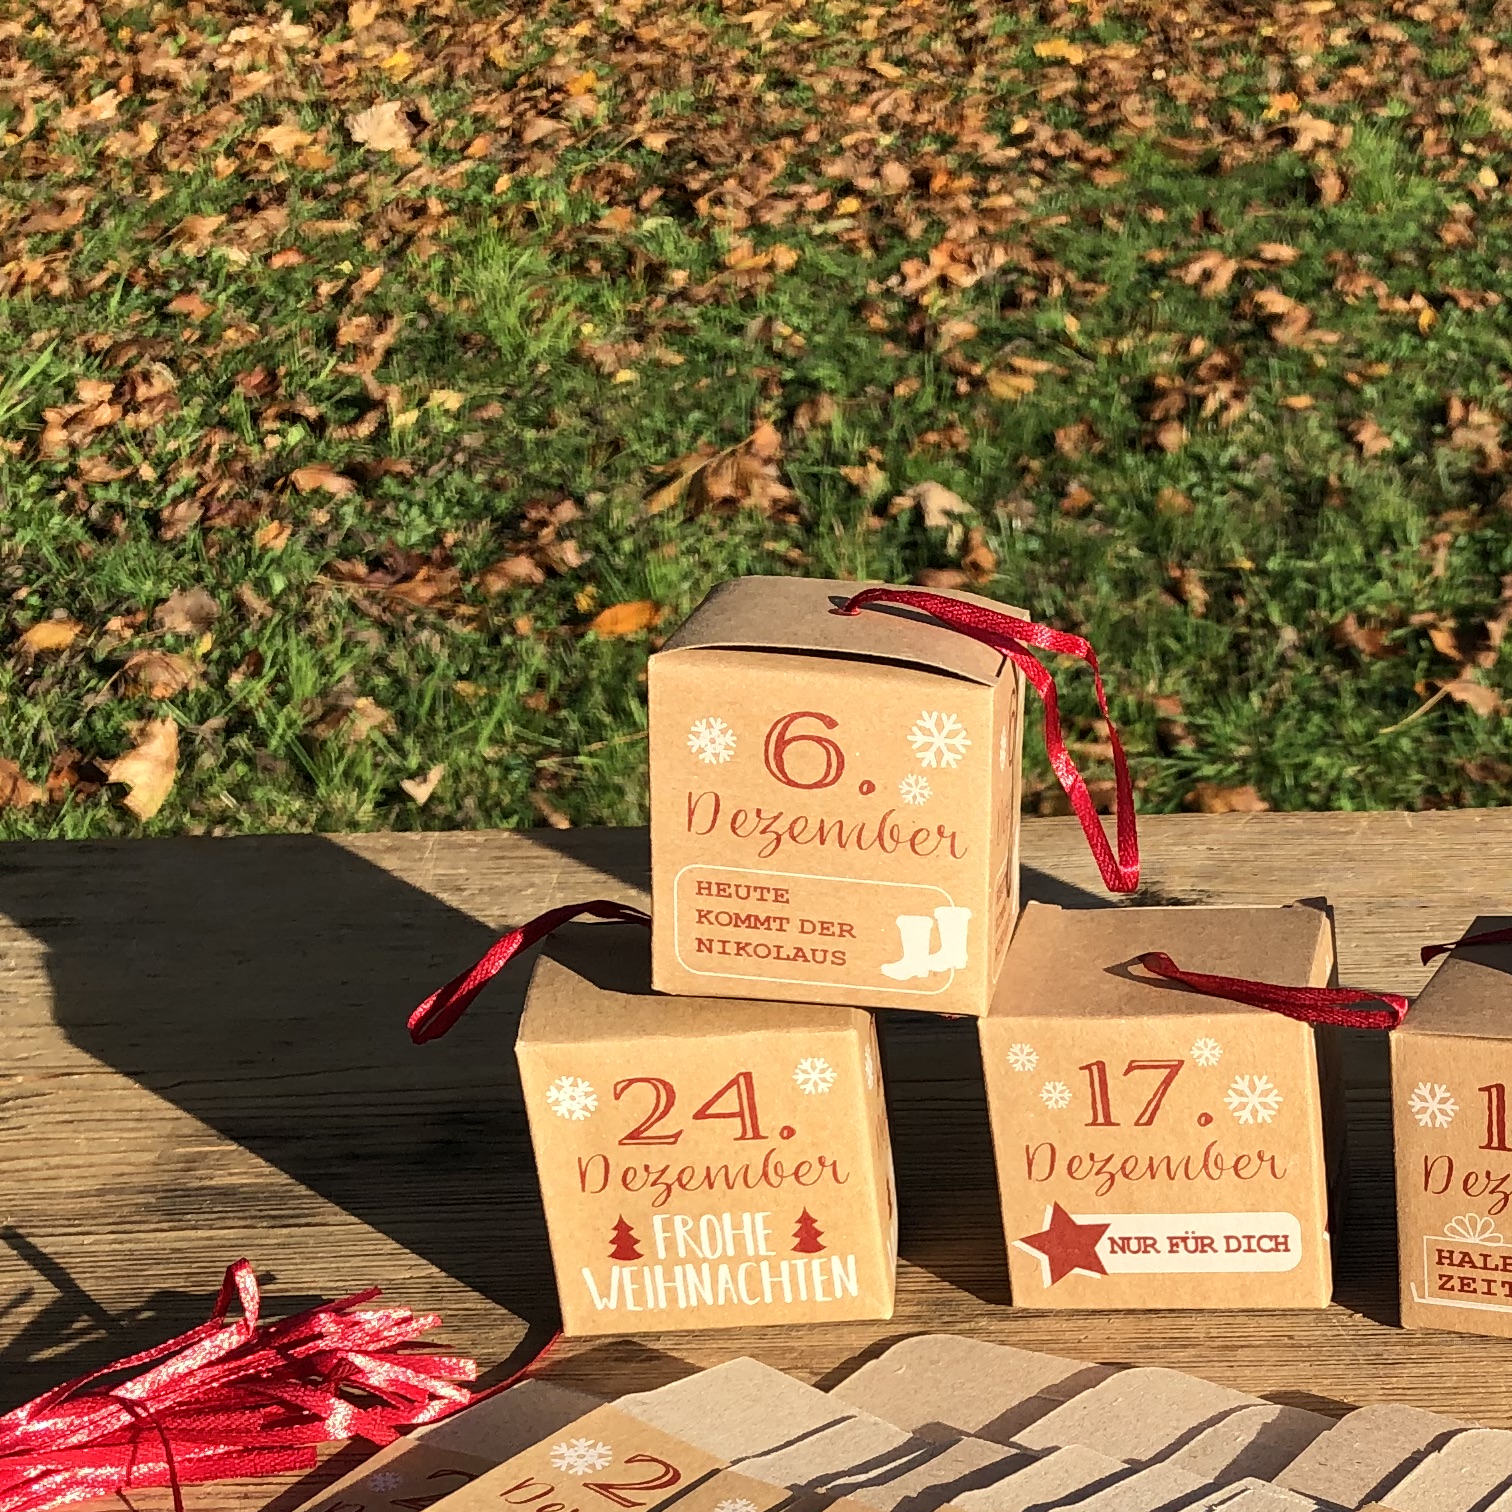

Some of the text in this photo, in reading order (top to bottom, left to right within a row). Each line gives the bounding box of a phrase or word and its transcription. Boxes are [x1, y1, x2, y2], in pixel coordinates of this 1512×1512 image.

[764, 711, 876, 795] 6.
[685, 790, 968, 859] Dezember
[695, 880, 790, 905] HEUTE
[695, 908, 857, 939] KOMMT DER
[695, 937, 847, 966] NIKOLAUS
[613, 1071, 797, 1146] 24.
[1078, 1059, 1214, 1128] 17.
[577, 1147, 850, 1208] Dezember
[1025, 1140, 1287, 1197] Dezember
[652, 1211, 777, 1260] FROHE
[1107, 1230, 1291, 1254] NUR FÜR DICH
[581, 1254, 859, 1311] WEIHNACHTEN
